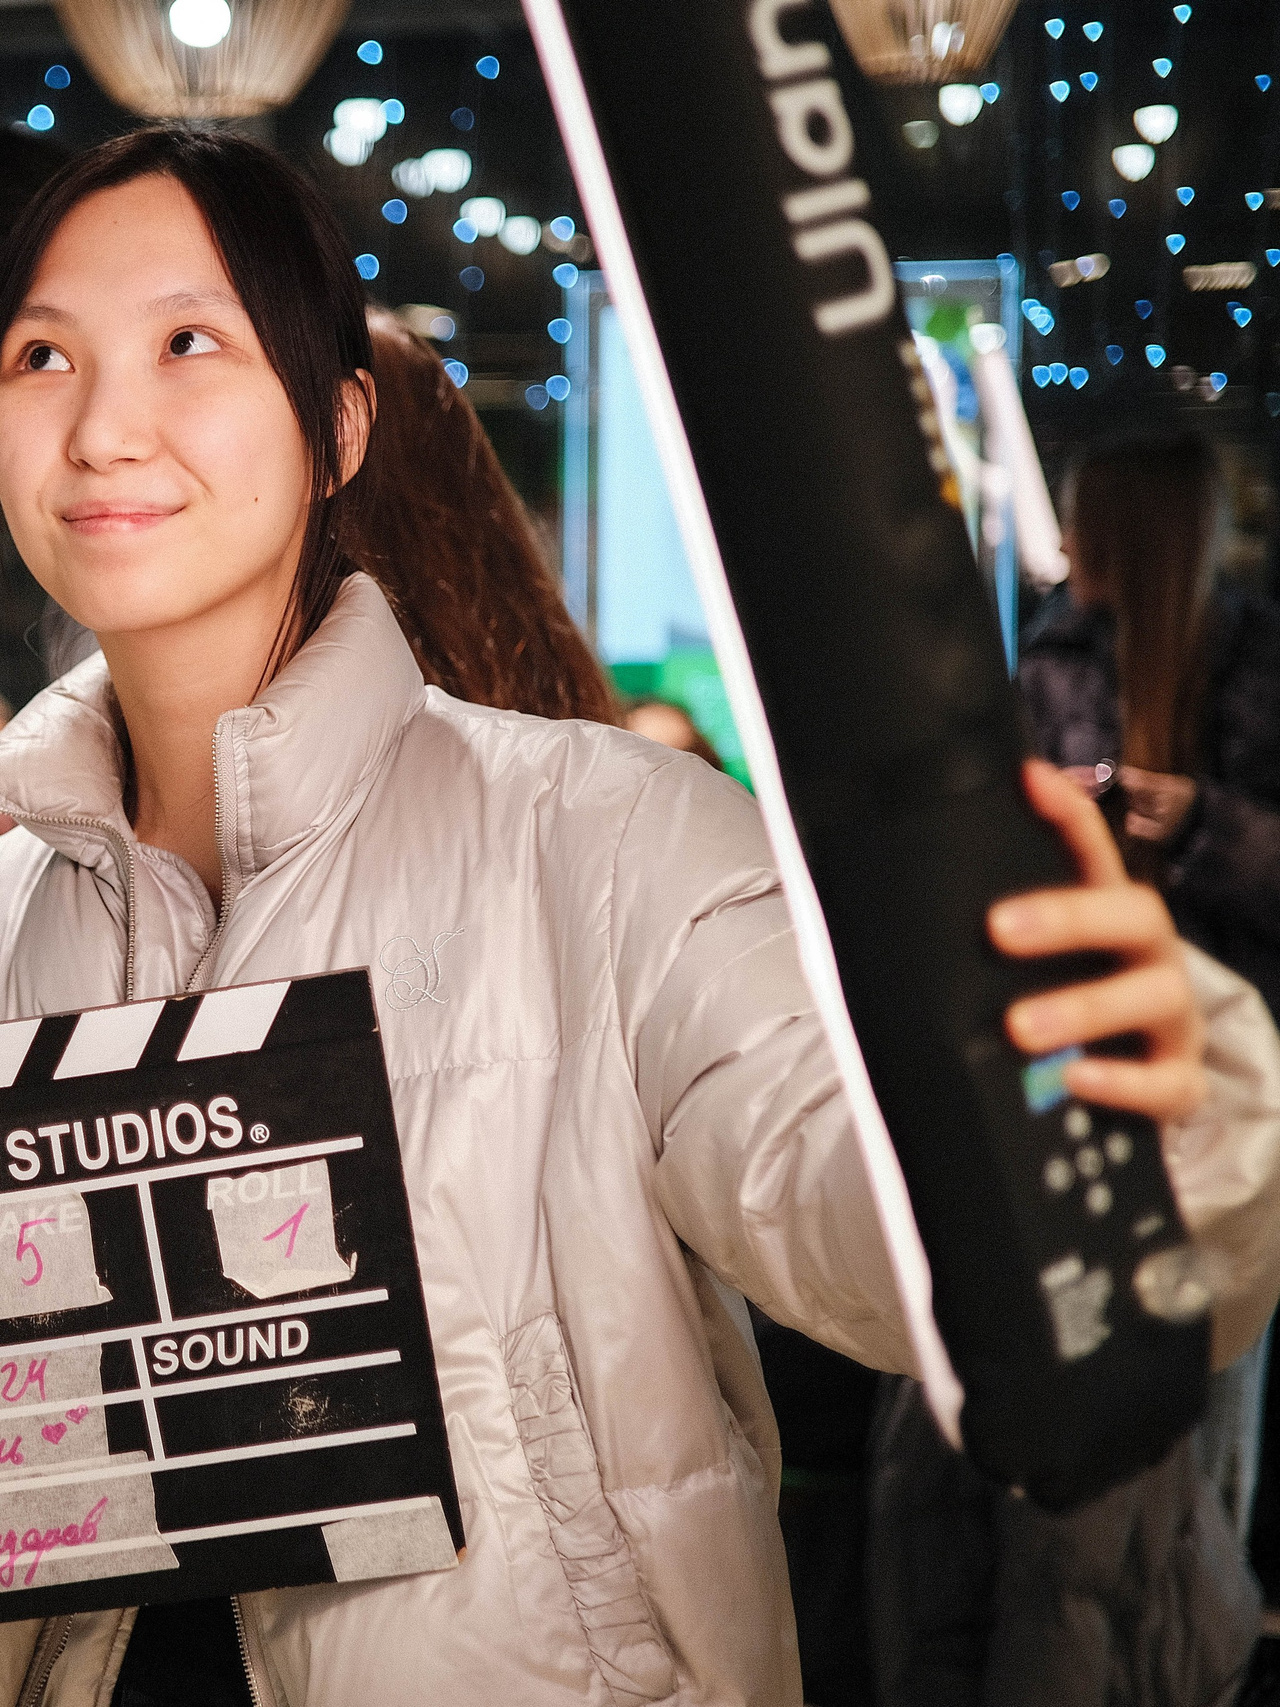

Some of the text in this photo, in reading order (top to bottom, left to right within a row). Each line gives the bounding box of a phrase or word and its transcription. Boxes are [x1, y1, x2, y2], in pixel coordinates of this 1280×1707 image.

[207, 1163, 323, 1210] ROLL
[15, 1217, 58, 1286] 5
[262, 1203, 310, 1258] 1
[152, 1320, 309, 1376] SOUND
